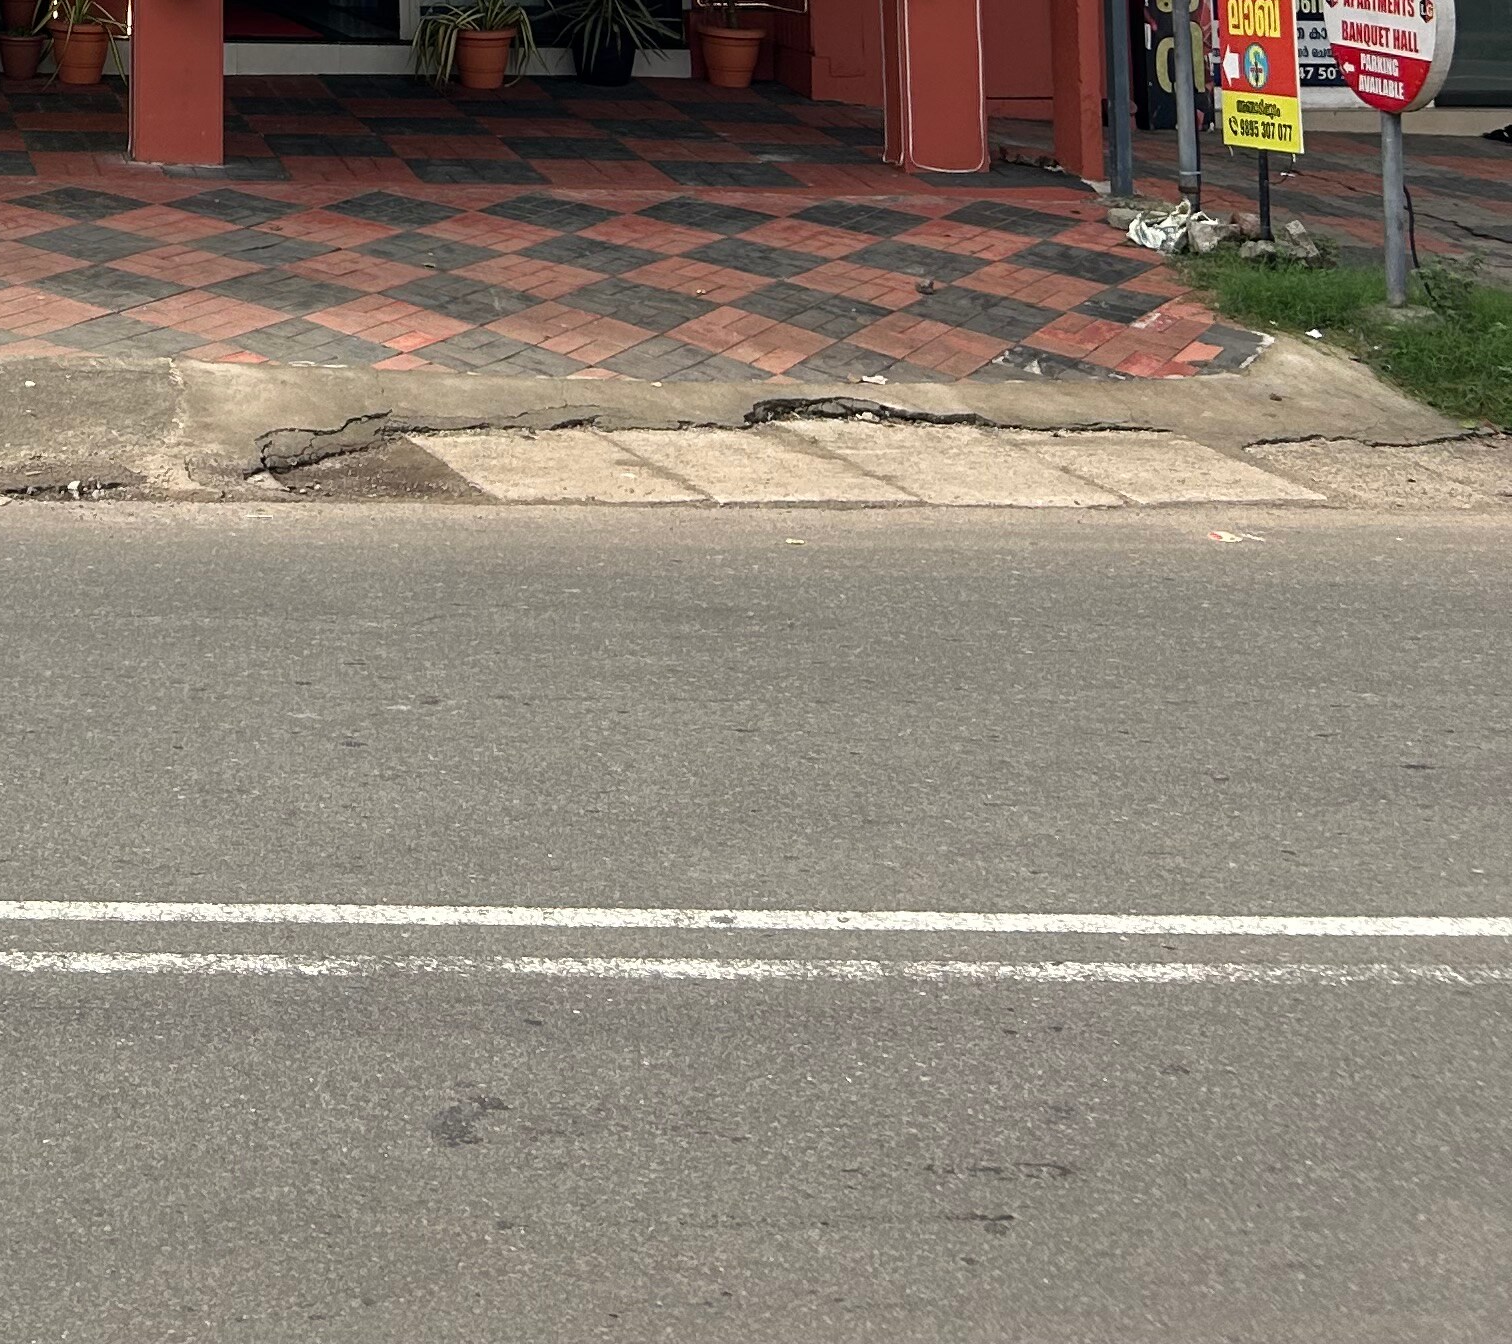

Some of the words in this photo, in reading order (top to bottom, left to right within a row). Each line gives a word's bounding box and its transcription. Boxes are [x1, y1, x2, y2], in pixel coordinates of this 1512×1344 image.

[1341, 20, 1391, 49] BANQUET
[1392, 28, 1419, 53] HALL
[1360, 53, 1399, 77] PARKING
[1358, 74, 1404, 100] AVAILABLE
